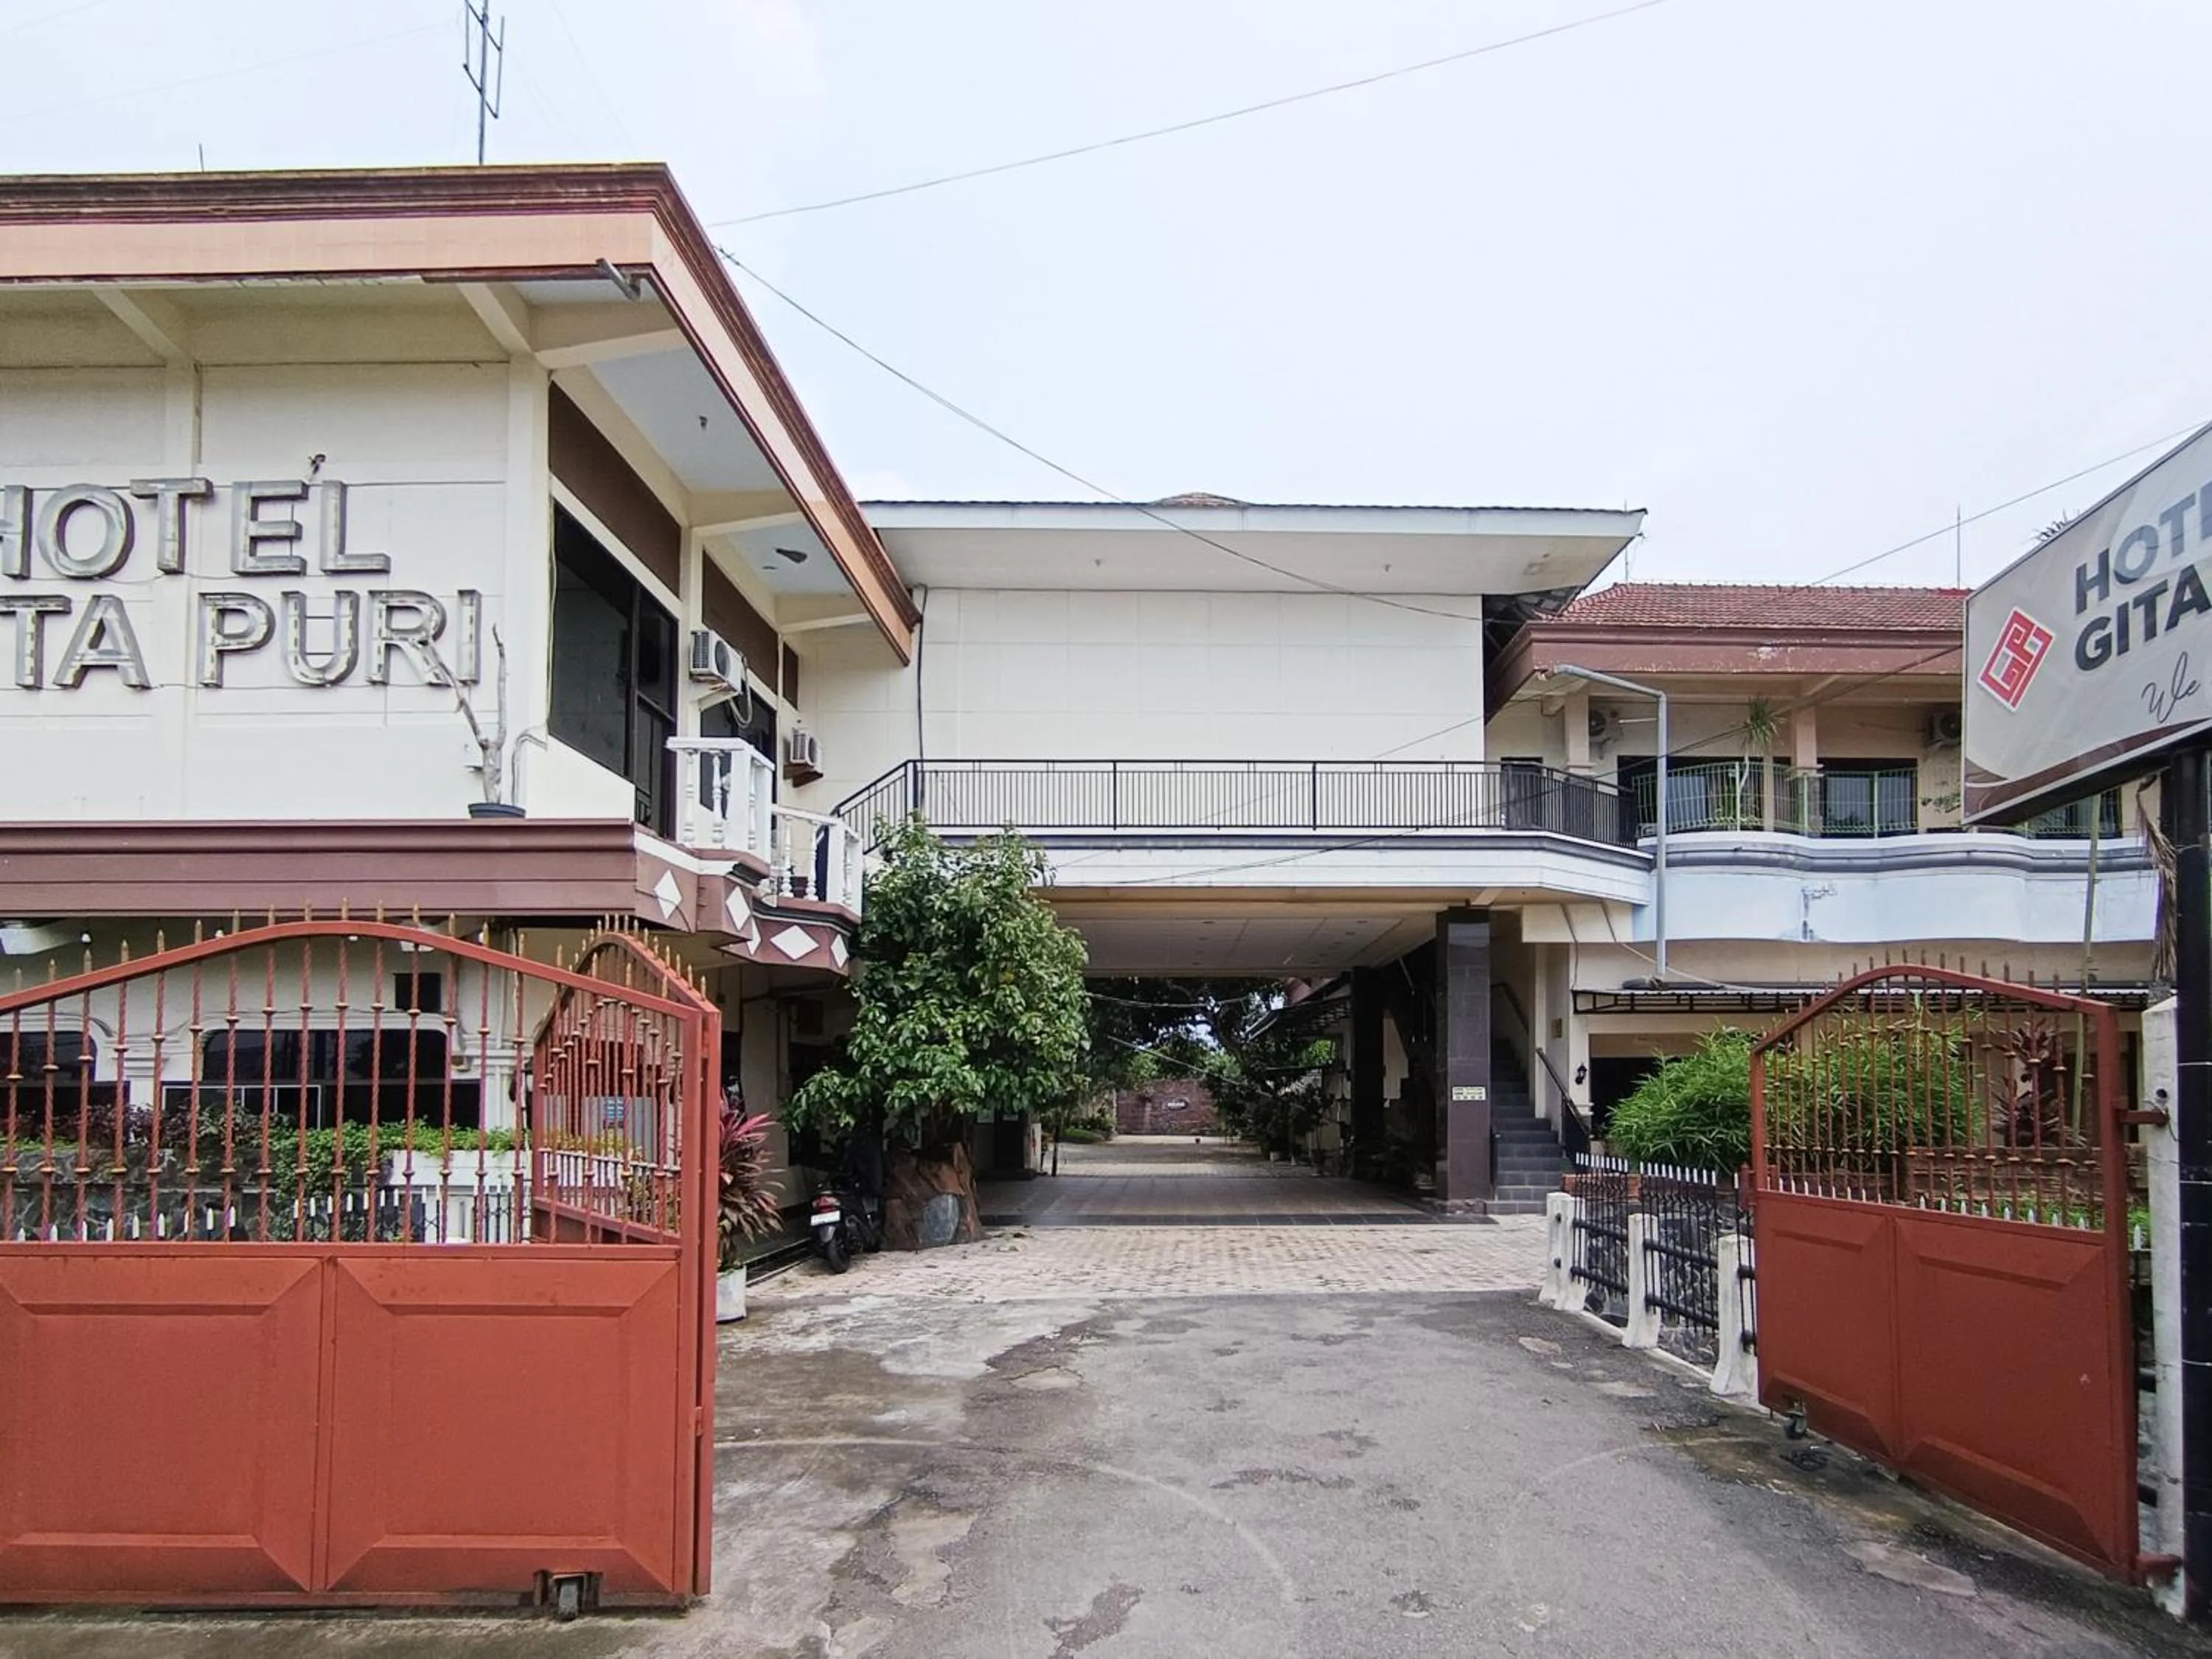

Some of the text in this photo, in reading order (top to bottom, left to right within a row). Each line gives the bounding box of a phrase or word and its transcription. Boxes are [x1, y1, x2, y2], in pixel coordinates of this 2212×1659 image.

[0, 589, 482, 690] TA PURI
[2074, 564, 2212, 672] GITA
[2140, 650, 2202, 724] We
